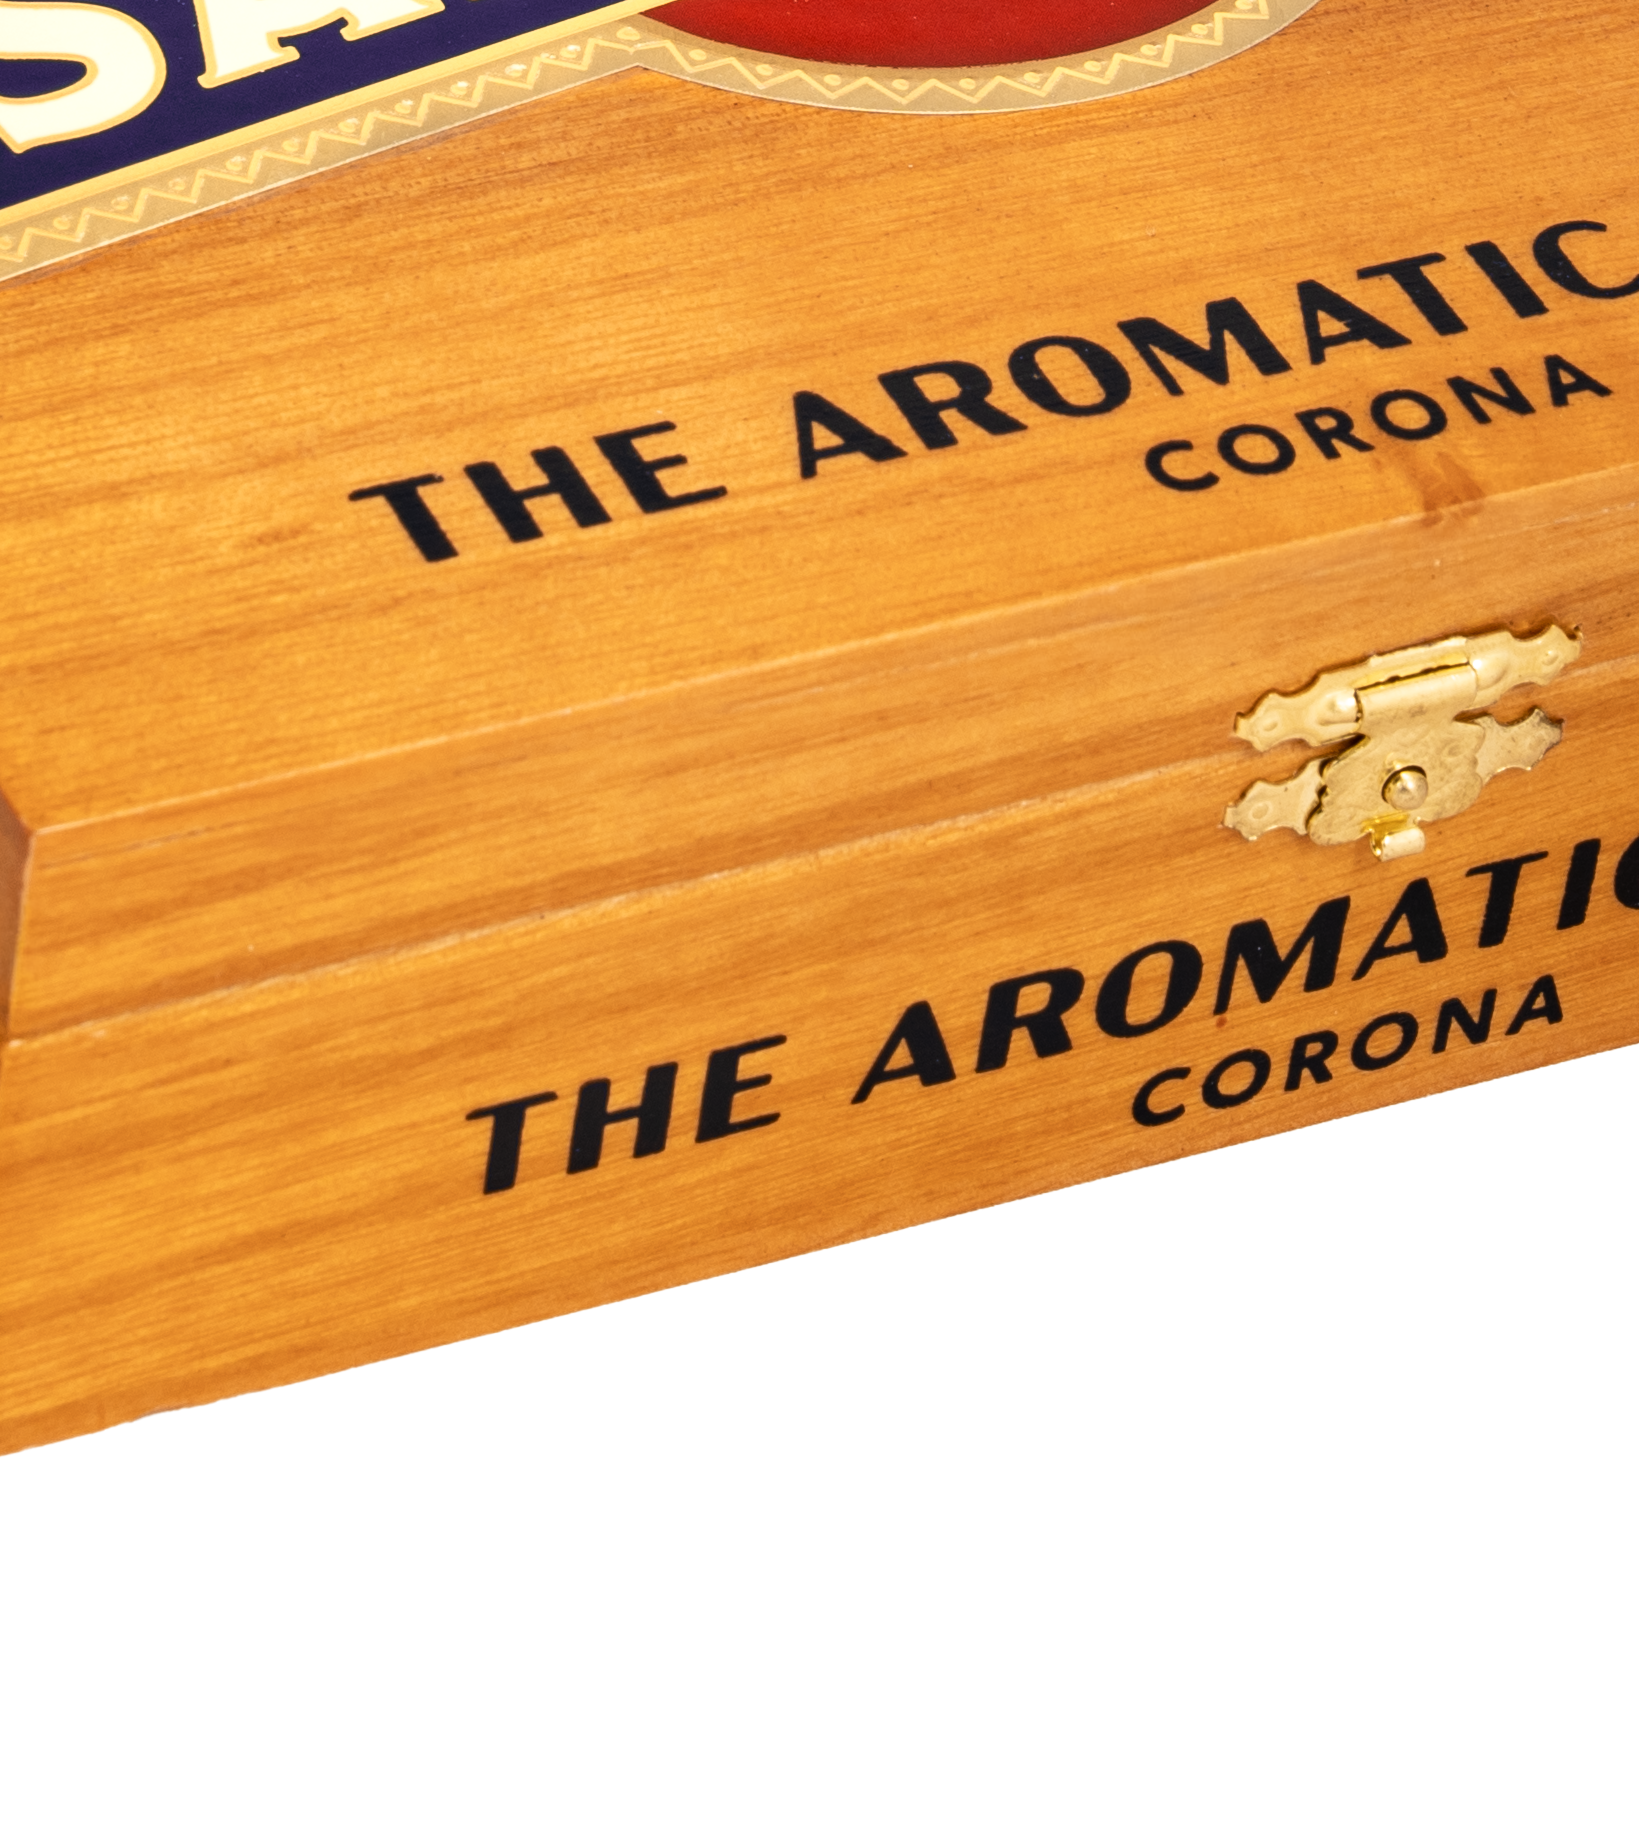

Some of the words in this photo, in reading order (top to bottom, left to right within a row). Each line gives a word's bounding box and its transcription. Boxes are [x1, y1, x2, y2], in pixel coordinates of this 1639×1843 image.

[348, 422, 727, 562] THE
[1145, 355, 1612, 491] CORONA
[466, 1035, 786, 1195] THE
[1131, 974, 1563, 1127] CORONA
